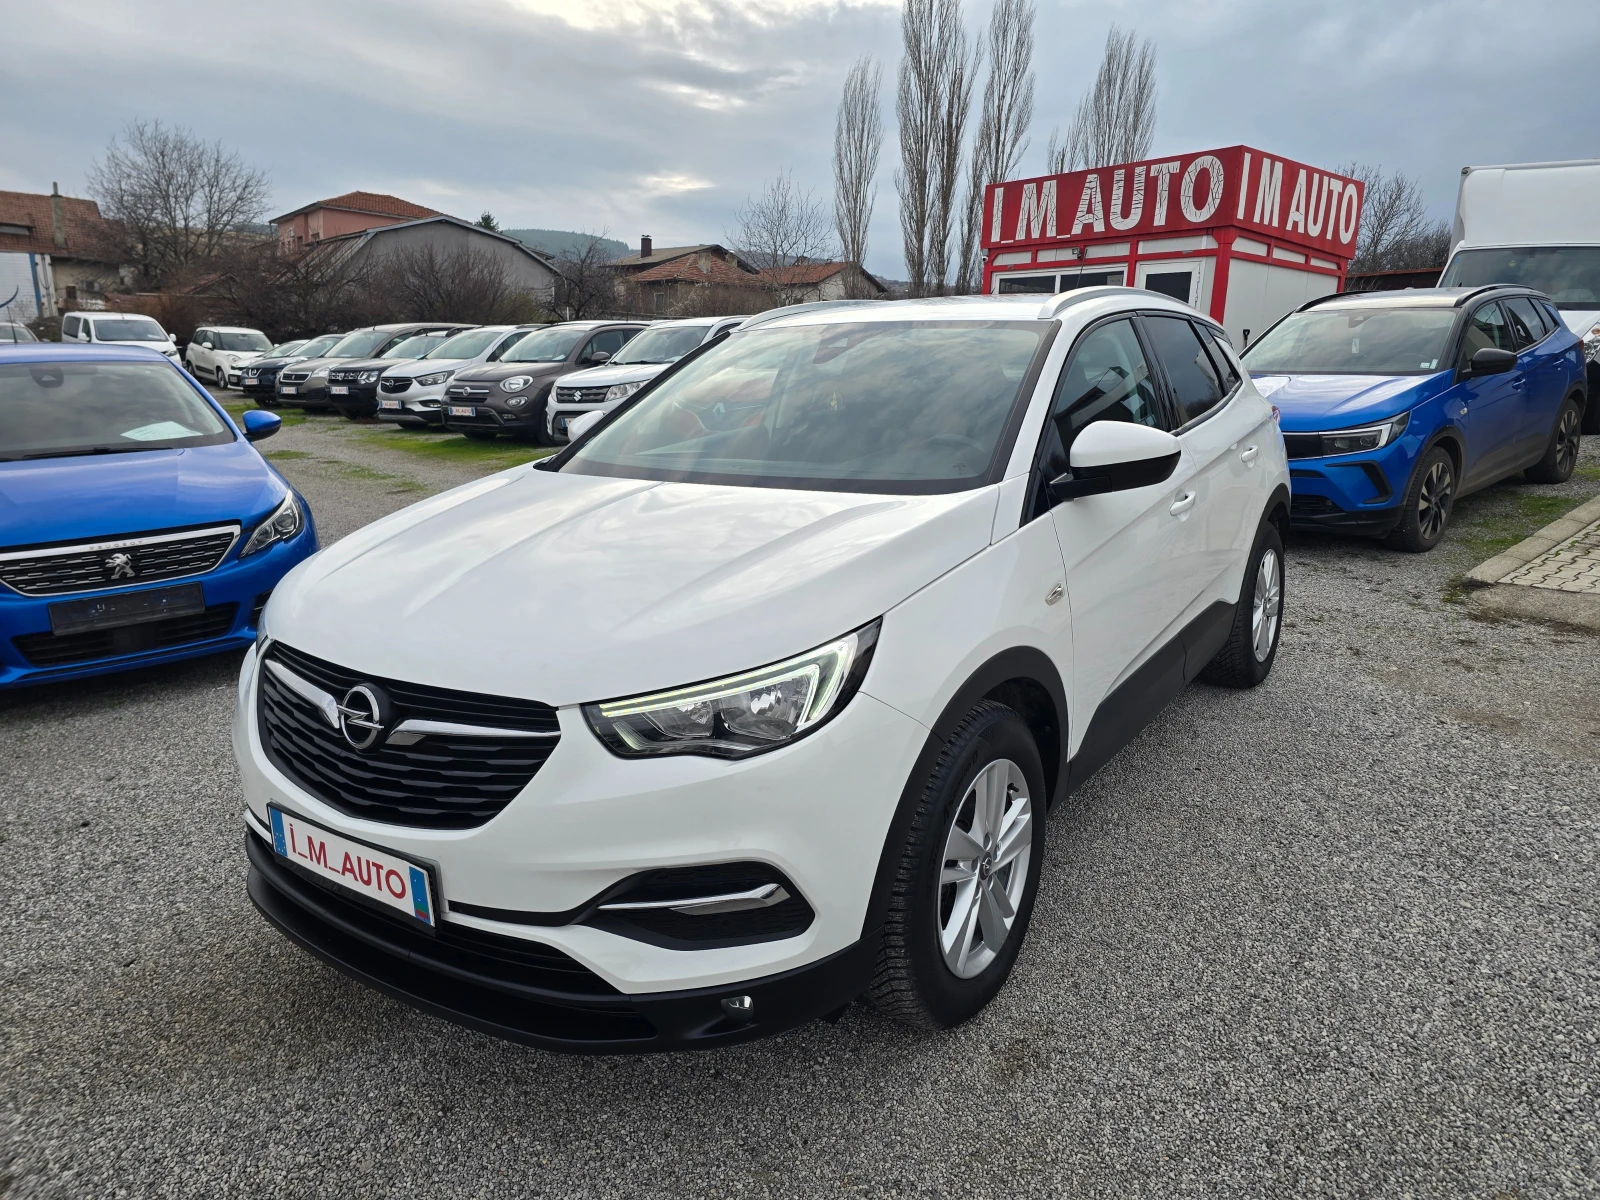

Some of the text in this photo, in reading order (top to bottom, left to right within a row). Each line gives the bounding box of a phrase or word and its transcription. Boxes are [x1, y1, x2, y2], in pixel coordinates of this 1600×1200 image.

[1236, 152, 1359, 246] I M AUTO
[89, 540, 143, 550] PEUGEOT
